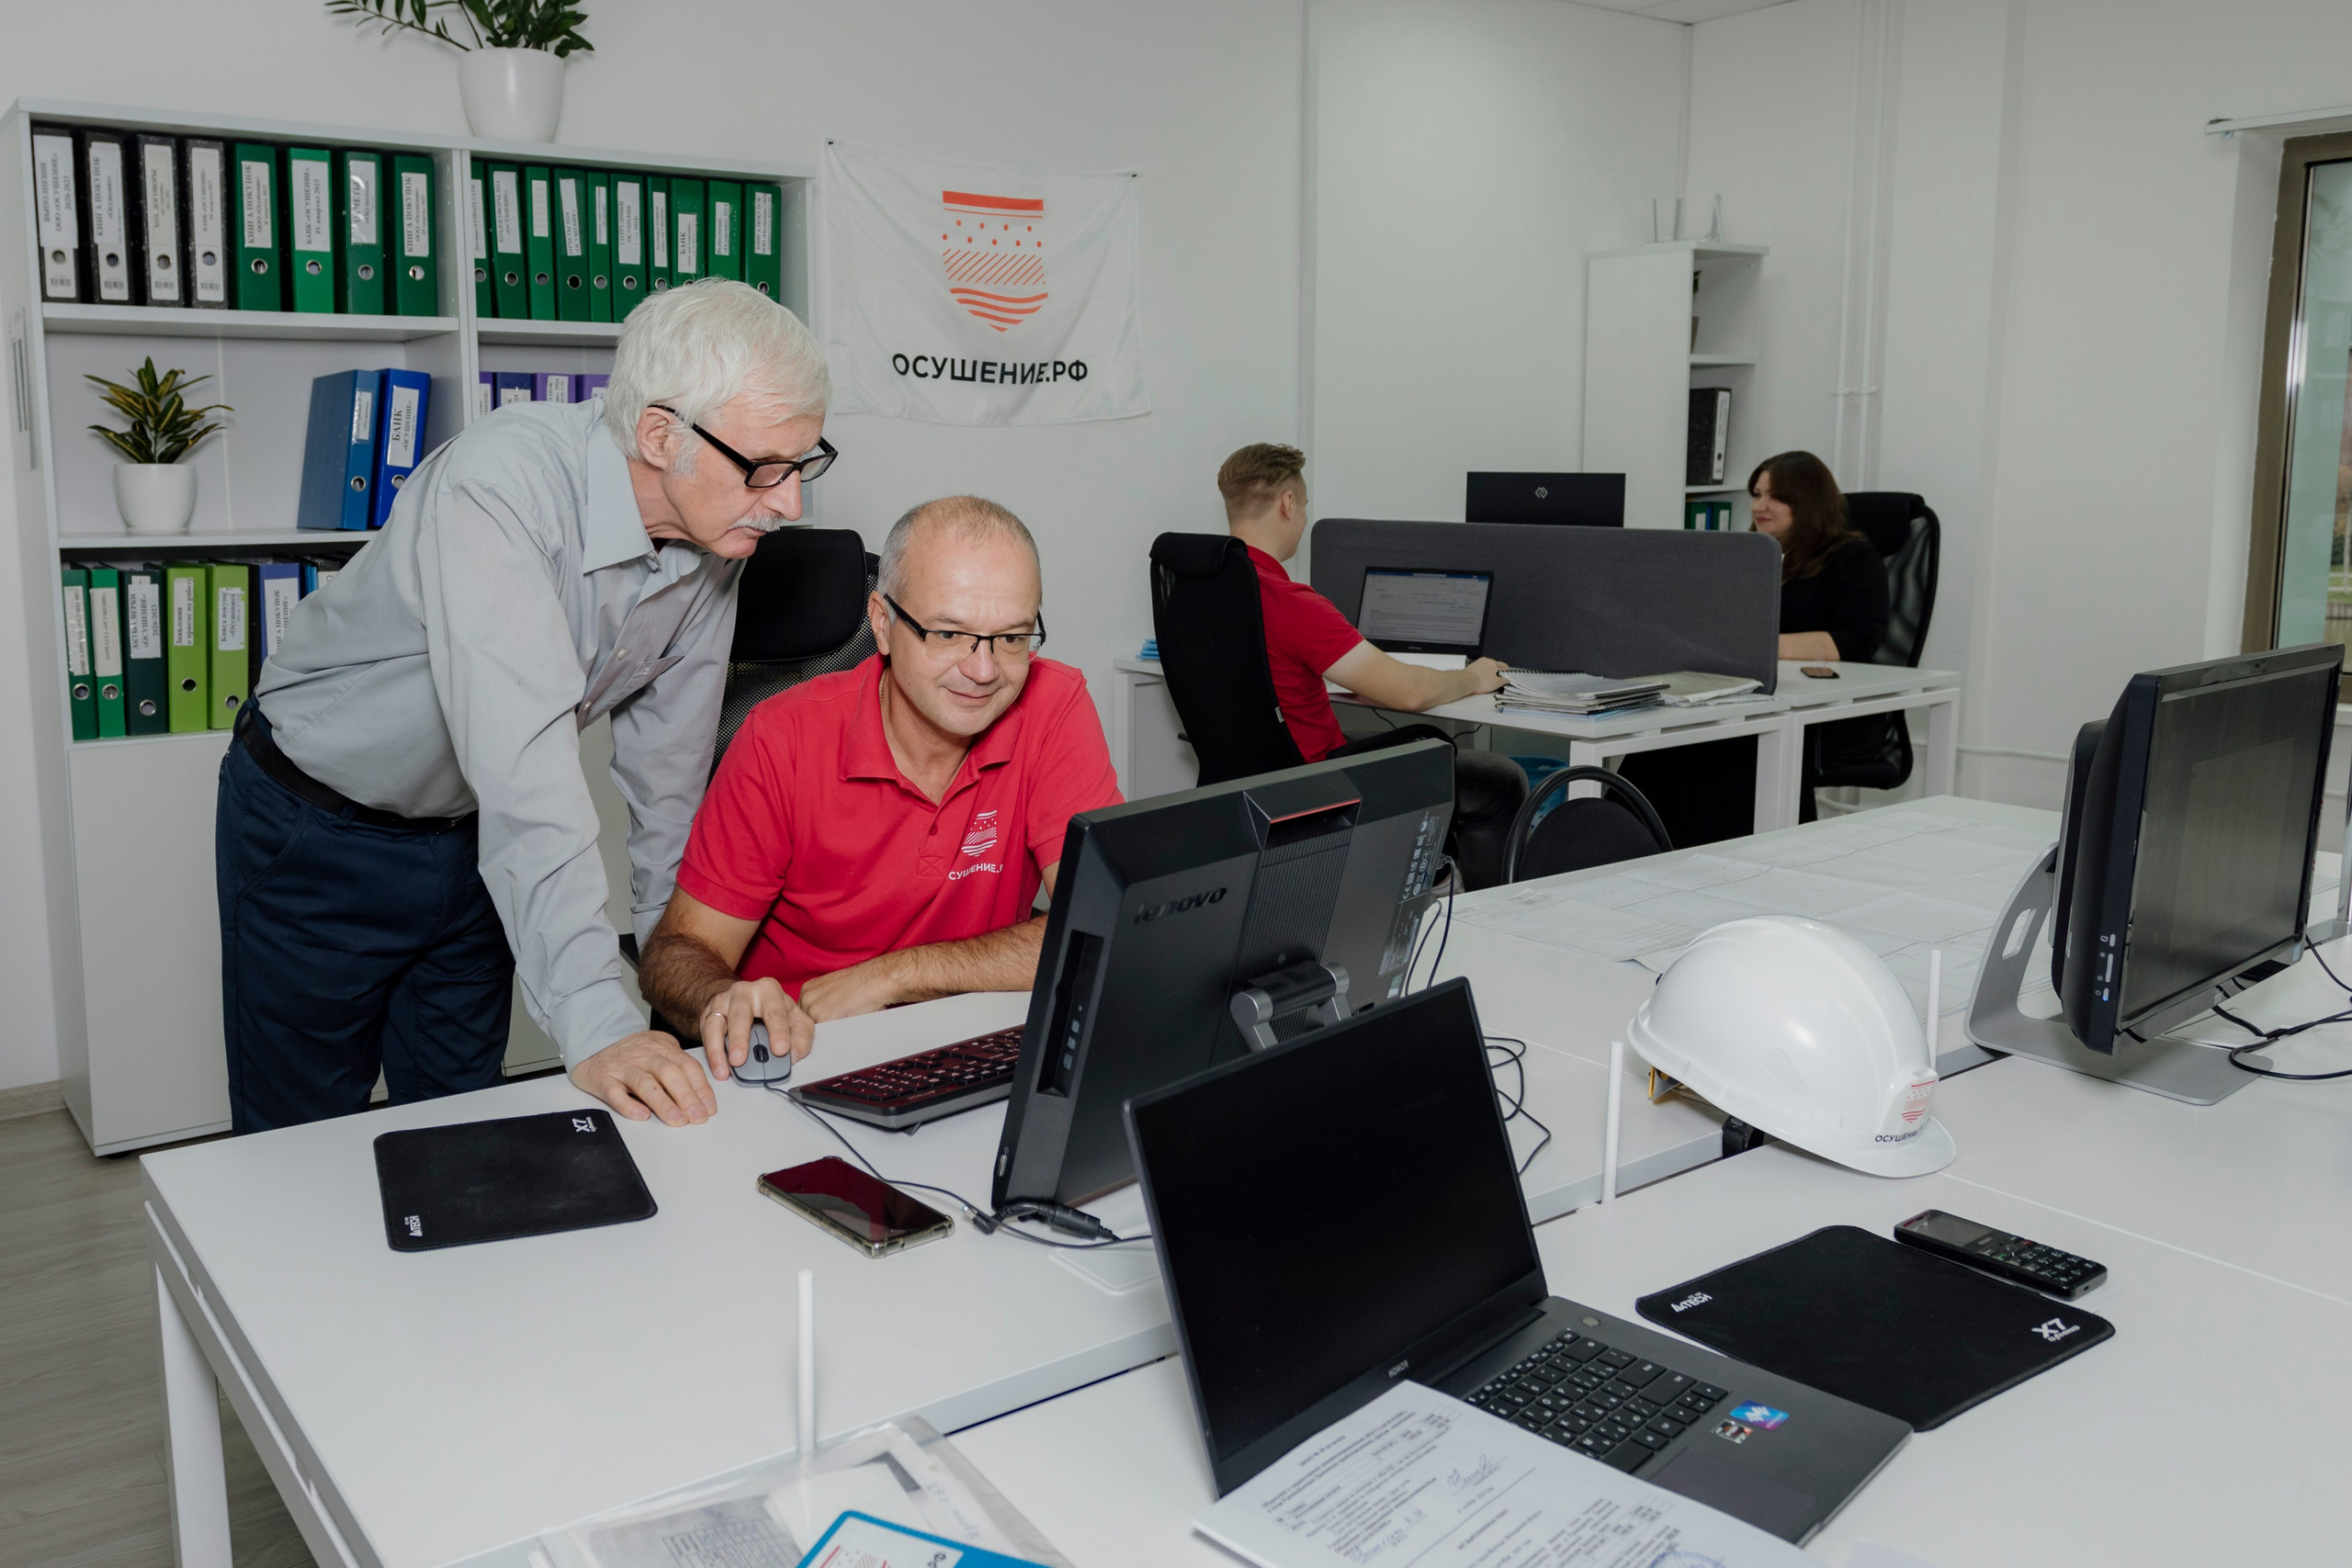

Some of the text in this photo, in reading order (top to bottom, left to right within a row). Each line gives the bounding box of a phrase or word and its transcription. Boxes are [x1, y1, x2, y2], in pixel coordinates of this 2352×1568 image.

[93, 157, 101, 203] ПОКУПОК
[244, 164, 254, 209] ПОКУПОК
[404, 175, 413, 220] ПОКУПОК
[315, 225, 321, 233] IV
[892, 353, 1089, 385] ОСУШЕНИЕ.РФ
[391, 409, 401, 441] БАНК
[403, 400, 412, 451] «ОСУШЕНИЕ»
[141, 594, 149, 648] «ОСУШЕНИЕ»
[187, 603, 192, 611] на
[2031, 1317, 2066, 1339] X7
